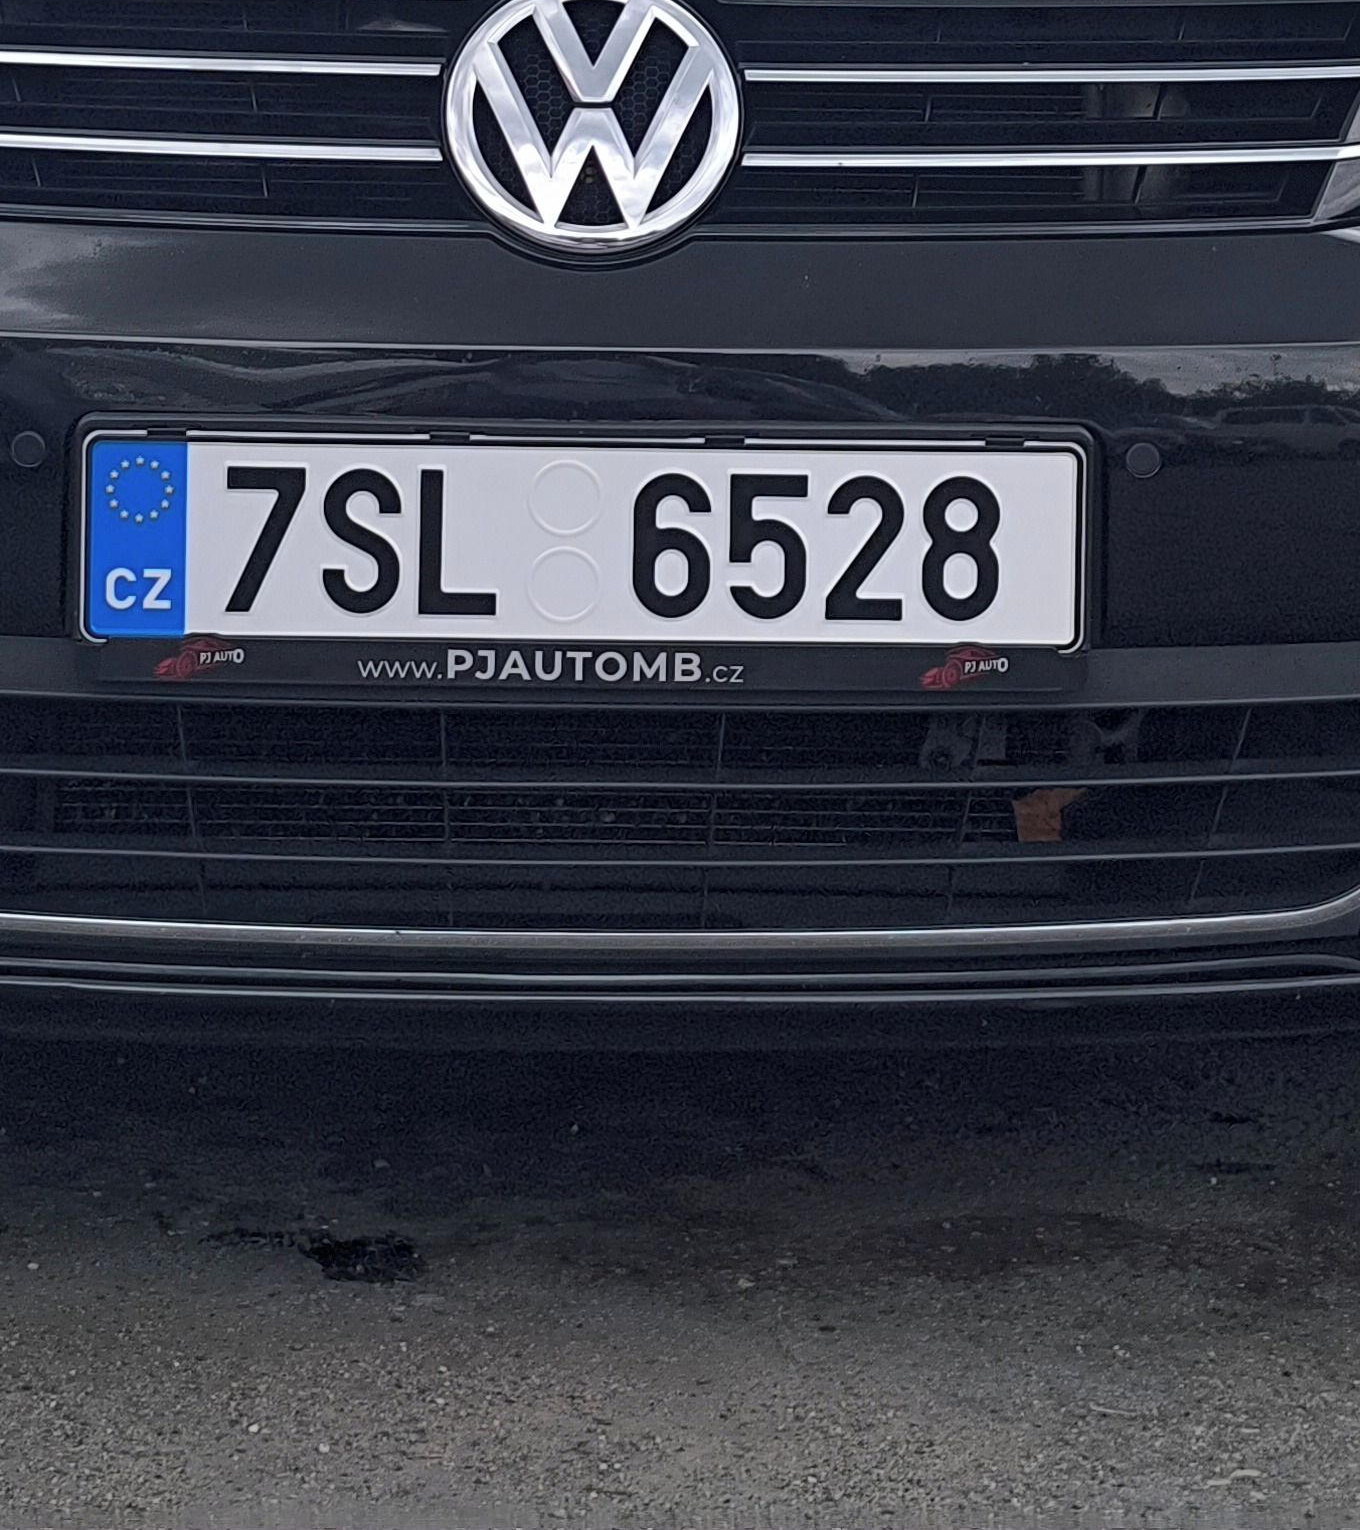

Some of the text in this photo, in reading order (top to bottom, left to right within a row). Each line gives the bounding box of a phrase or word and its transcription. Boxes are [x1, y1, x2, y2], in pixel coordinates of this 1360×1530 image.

[224, 465, 1001, 622] 7SL 6528
[104, 566, 173, 611] CZ
[199, 648, 245, 665] PJ AUTO
[964, 657, 1009, 674] PJ AUTO
